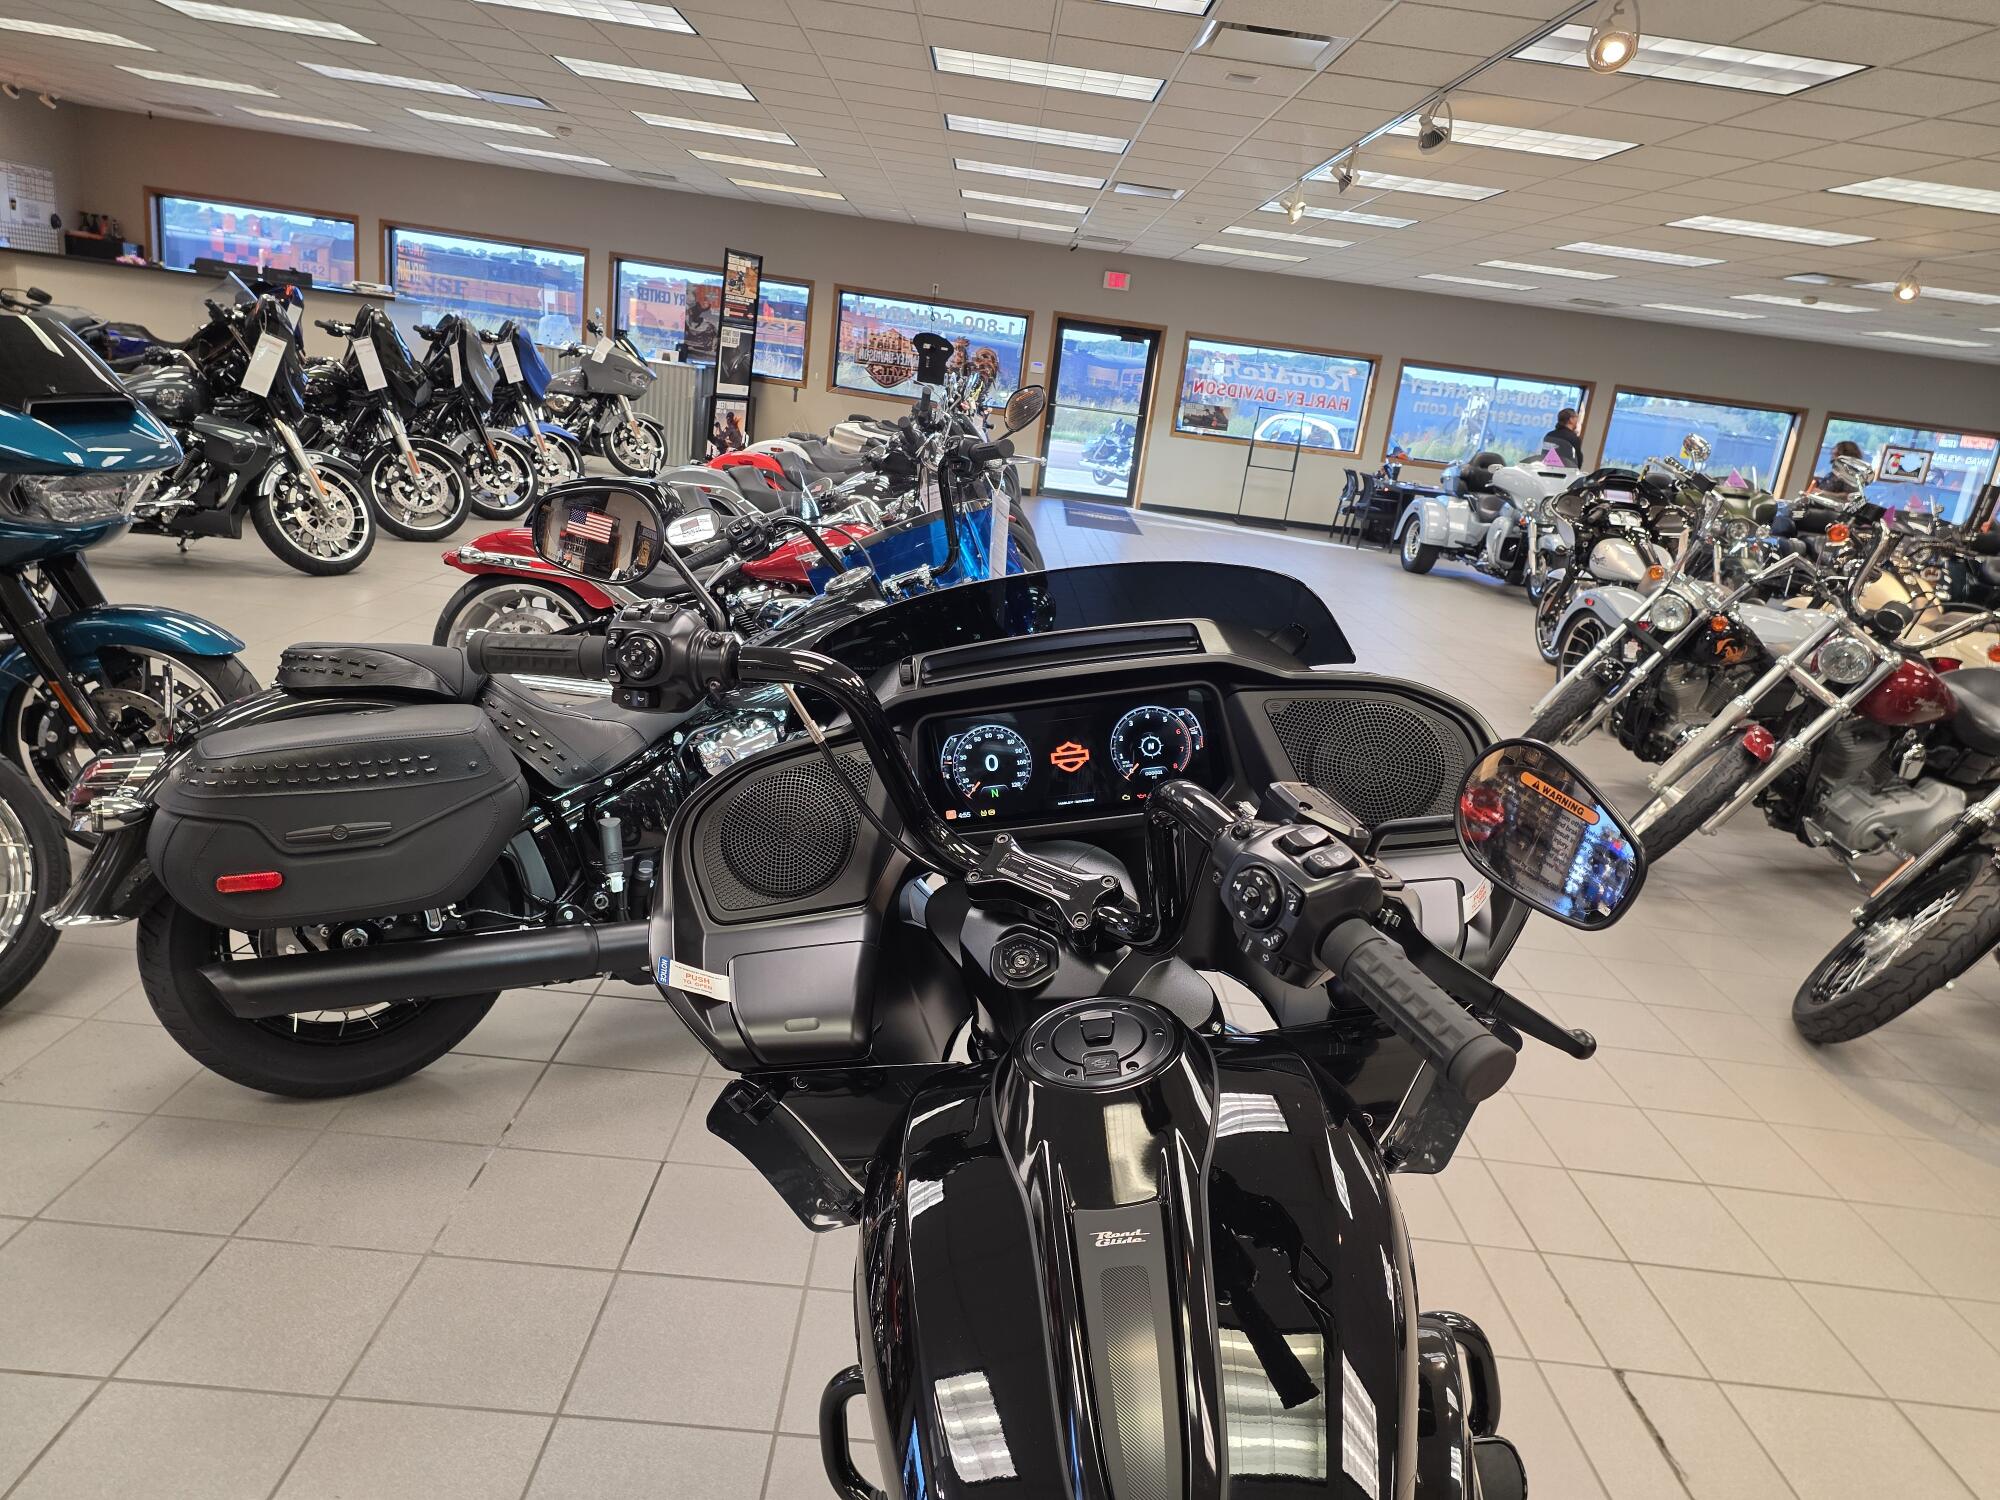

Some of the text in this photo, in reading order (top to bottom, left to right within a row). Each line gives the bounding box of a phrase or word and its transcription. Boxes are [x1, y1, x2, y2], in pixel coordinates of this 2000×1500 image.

[1148, 742, 1154, 750] N
[985, 754, 999, 772] 0
[991, 789, 999, 798] N
[1542, 785, 1584, 816] WARNING
[685, 972, 710, 984] PUSH
[695, 982, 712, 990] OPEN
[1089, 1229, 1151, 1240] Road
[1095, 1237, 1146, 1247] Glide
